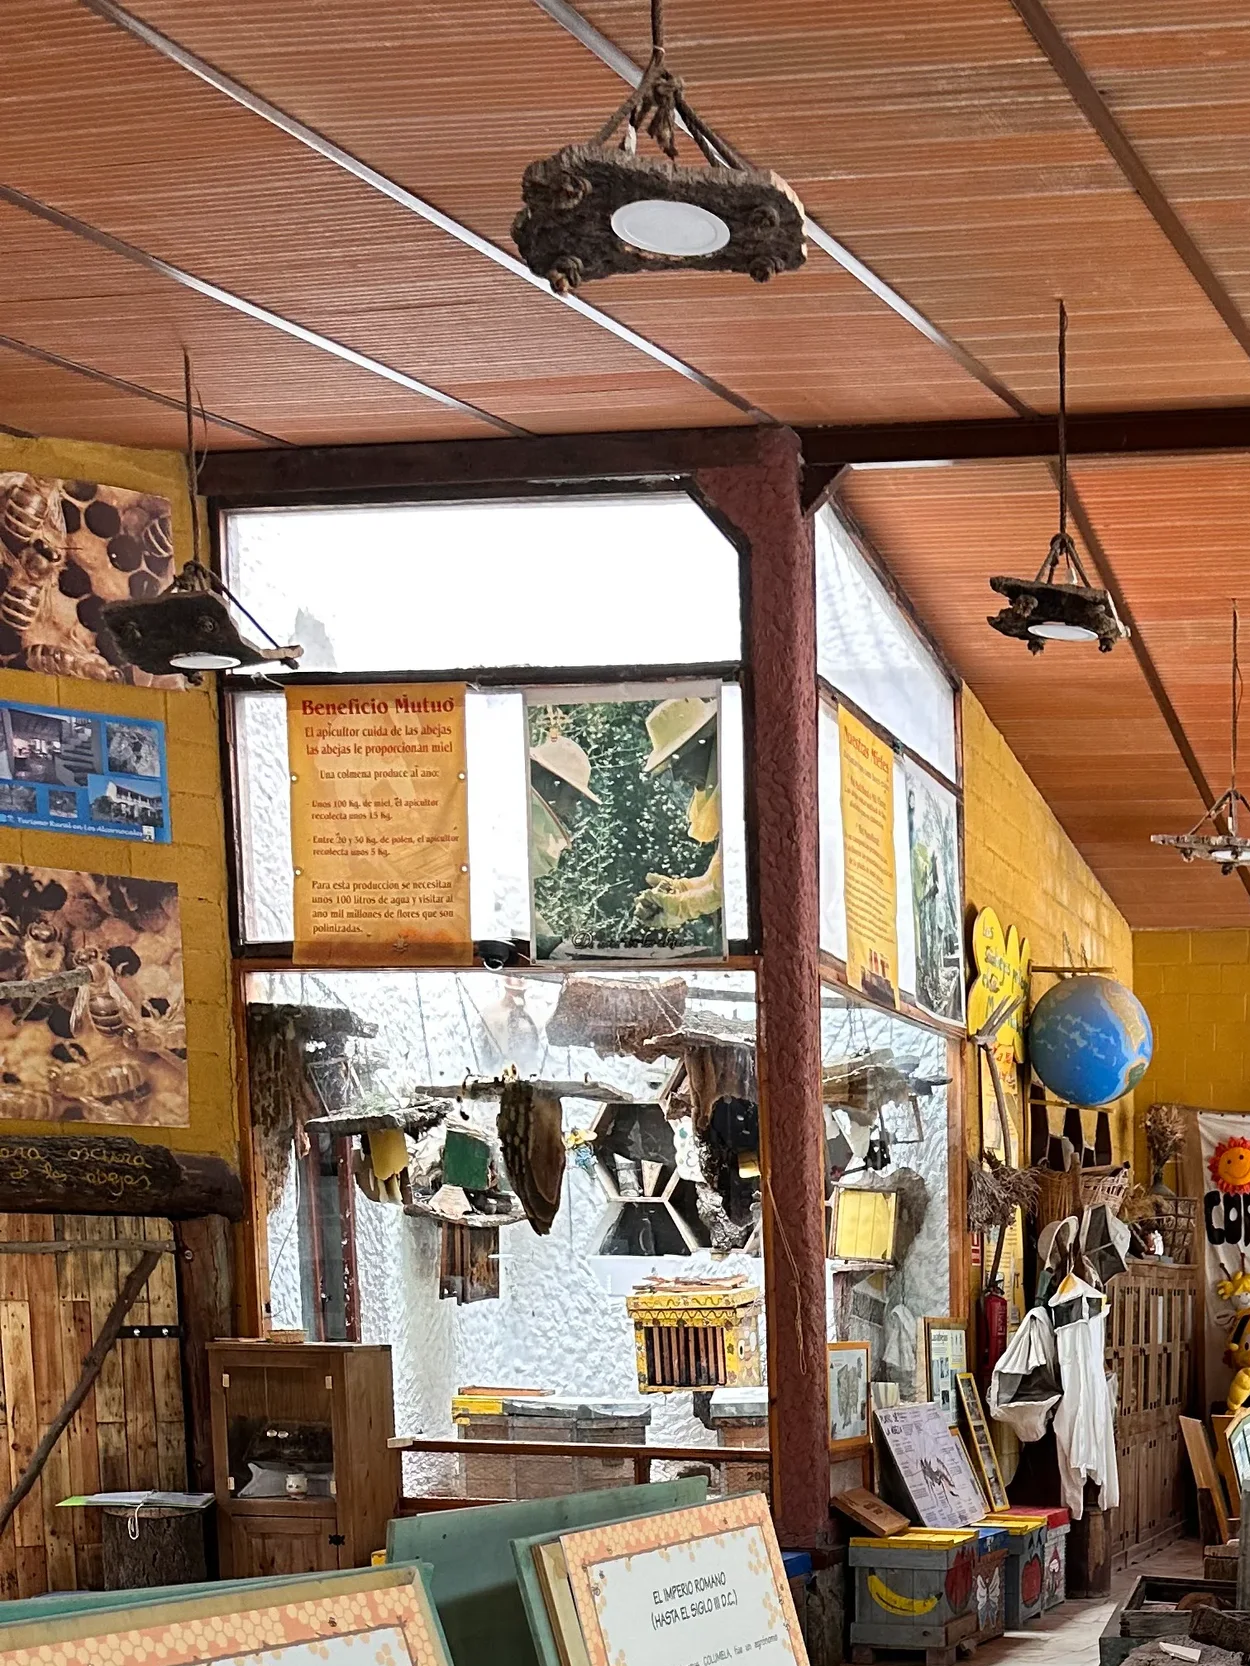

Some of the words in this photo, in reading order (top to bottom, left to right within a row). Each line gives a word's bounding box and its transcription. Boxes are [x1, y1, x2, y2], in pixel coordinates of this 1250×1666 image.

[301, 697, 388, 715] Beneficio
[394, 696, 454, 714] Mutuo
[304, 726, 314, 737] El
[315, 726, 360, 740] apicultor
[361, 725, 388, 737] cuida
[389, 724, 402, 736] de
[404, 724, 418, 735] las
[420, 724, 452, 737] abejas
[306, 743, 319, 755] las
[320, 743, 351, 757] abejas
[353, 742, 362, 754] le
[364, 741, 428, 756] proporcionan
[431, 740, 452, 752] miel
[652, 1590, 663, 1605] EL
[662, 1580, 693, 1602] IMPERIO
[693, 1570, 726, 1593] ROMANO
[650, 1608, 680, 1630] (HASTA
[679, 1605, 690, 1620] EL
[689, 1597, 713, 1617] SIGLO
[720, 1588, 737, 1607] D.C.)
